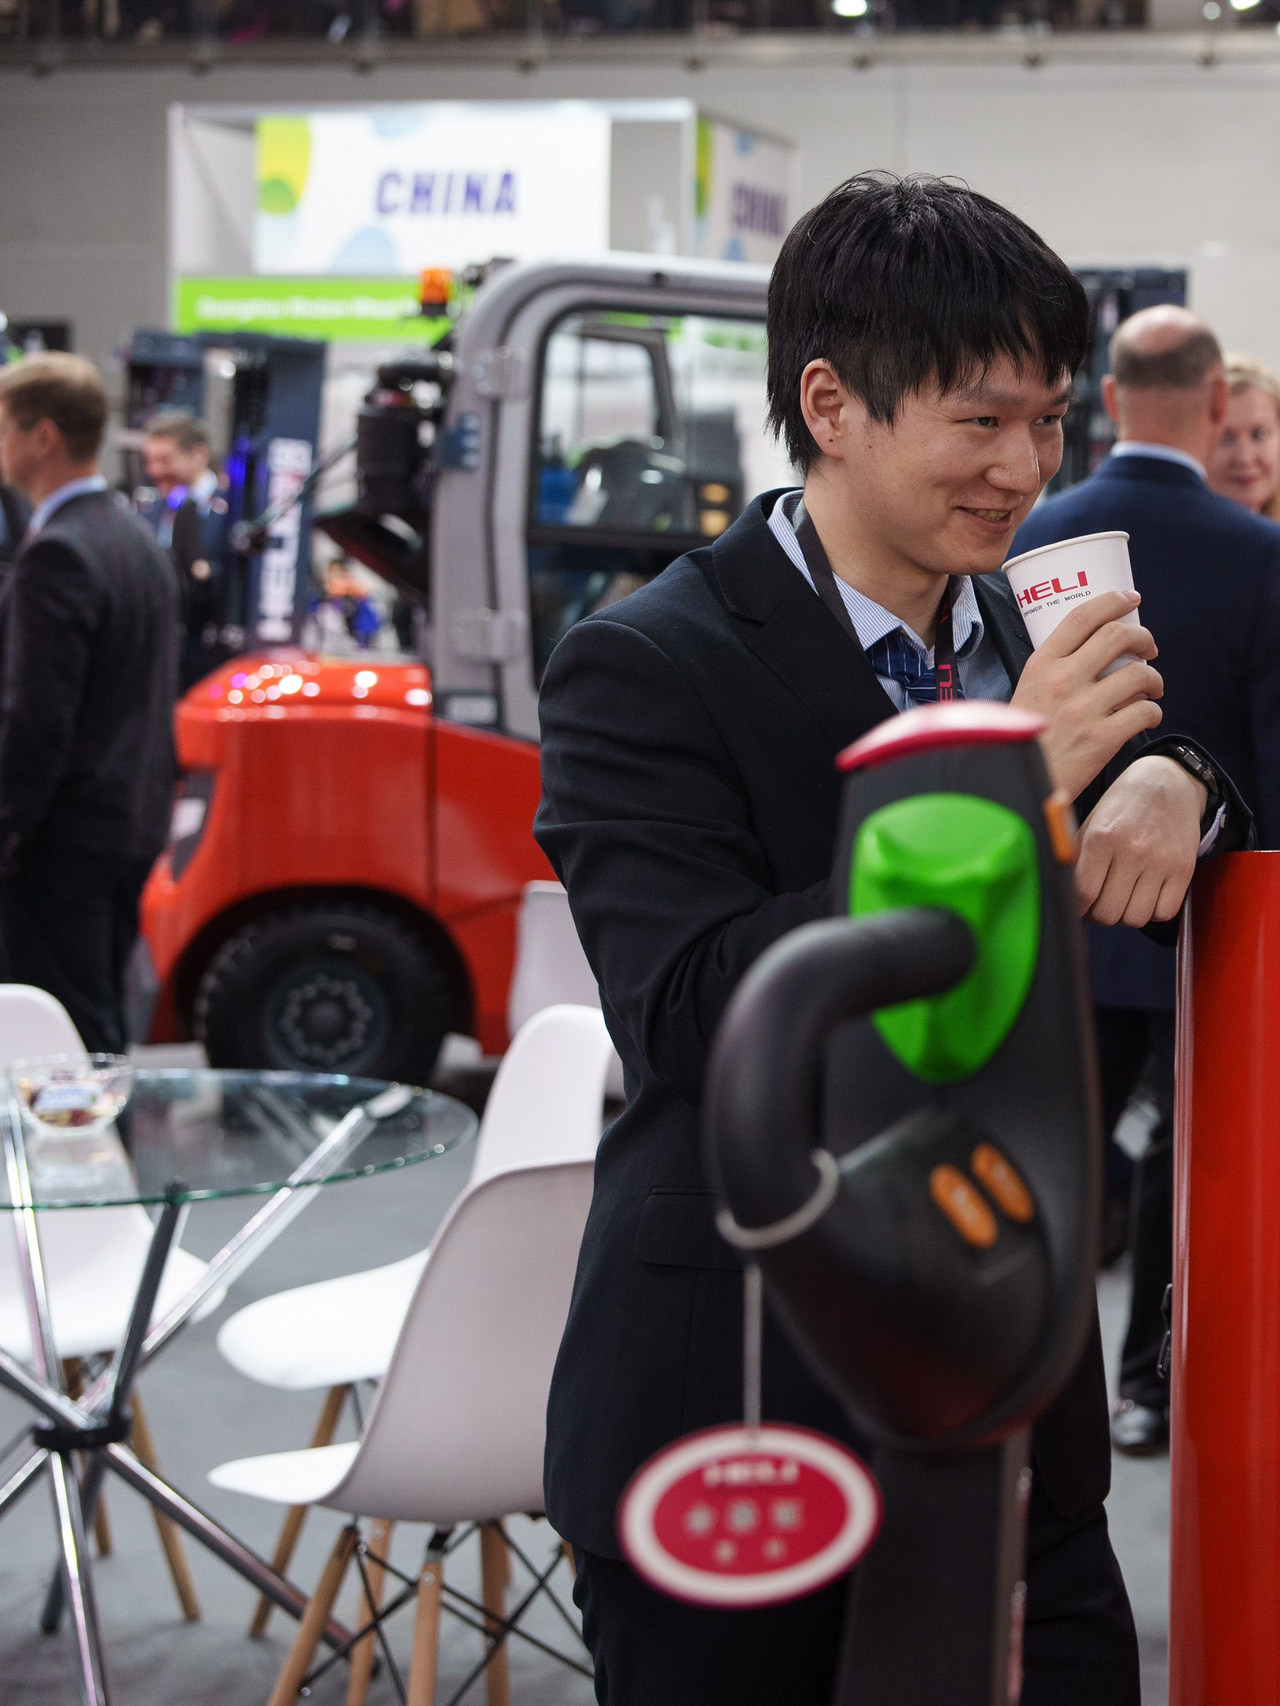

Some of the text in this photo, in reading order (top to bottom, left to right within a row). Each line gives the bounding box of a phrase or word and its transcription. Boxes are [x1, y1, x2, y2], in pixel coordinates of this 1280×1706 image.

[376, 172, 515, 215] CHINA
[1016, 571, 1088, 608] HELI
[1046, 599, 1060, 608] THE
[1064, 590, 1091, 601] WORLD
